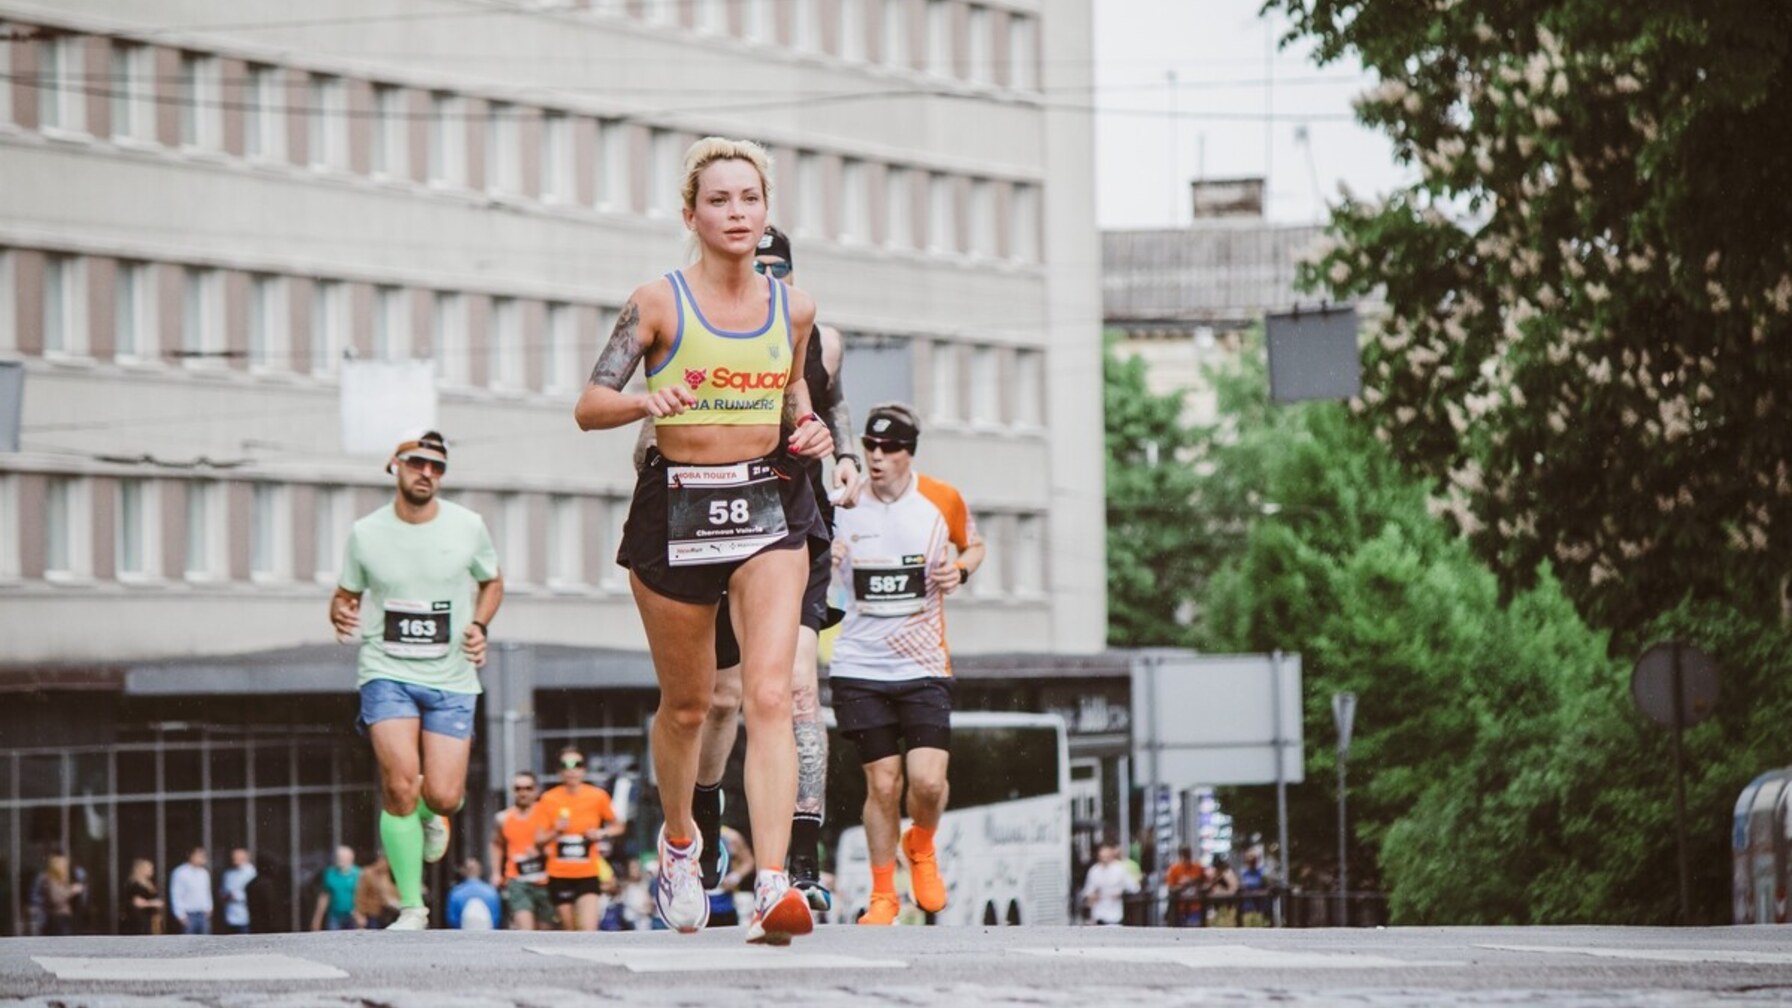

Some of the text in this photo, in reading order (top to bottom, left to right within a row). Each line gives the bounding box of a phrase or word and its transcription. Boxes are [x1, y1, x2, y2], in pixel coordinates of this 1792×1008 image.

[711, 367, 789, 393] Squad
[714, 399, 774, 410] RUNNERS
[703, 471, 737, 479] ПОШТА
[708, 498, 750, 525] 58
[696, 528, 734, 537] Chernous
[869, 575, 909, 593] 587
[398, 618, 437, 636] 163
